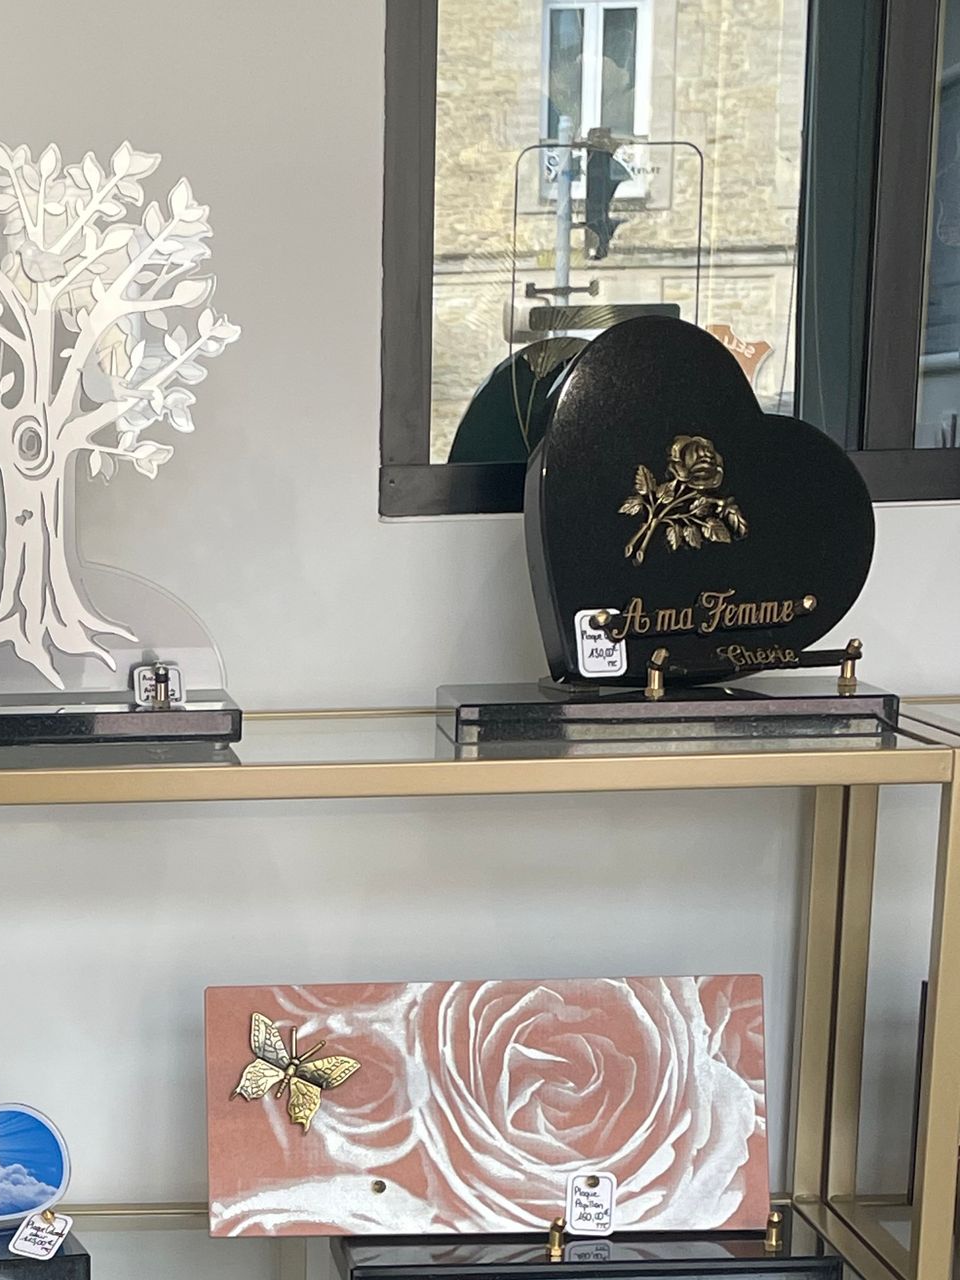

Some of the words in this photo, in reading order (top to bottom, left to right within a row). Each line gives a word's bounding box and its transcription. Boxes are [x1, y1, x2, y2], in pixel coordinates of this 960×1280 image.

[655, 607, 694, 632] ma
[699, 589, 794, 634] Femme
[574, 1185, 600, 1200] Plaque
